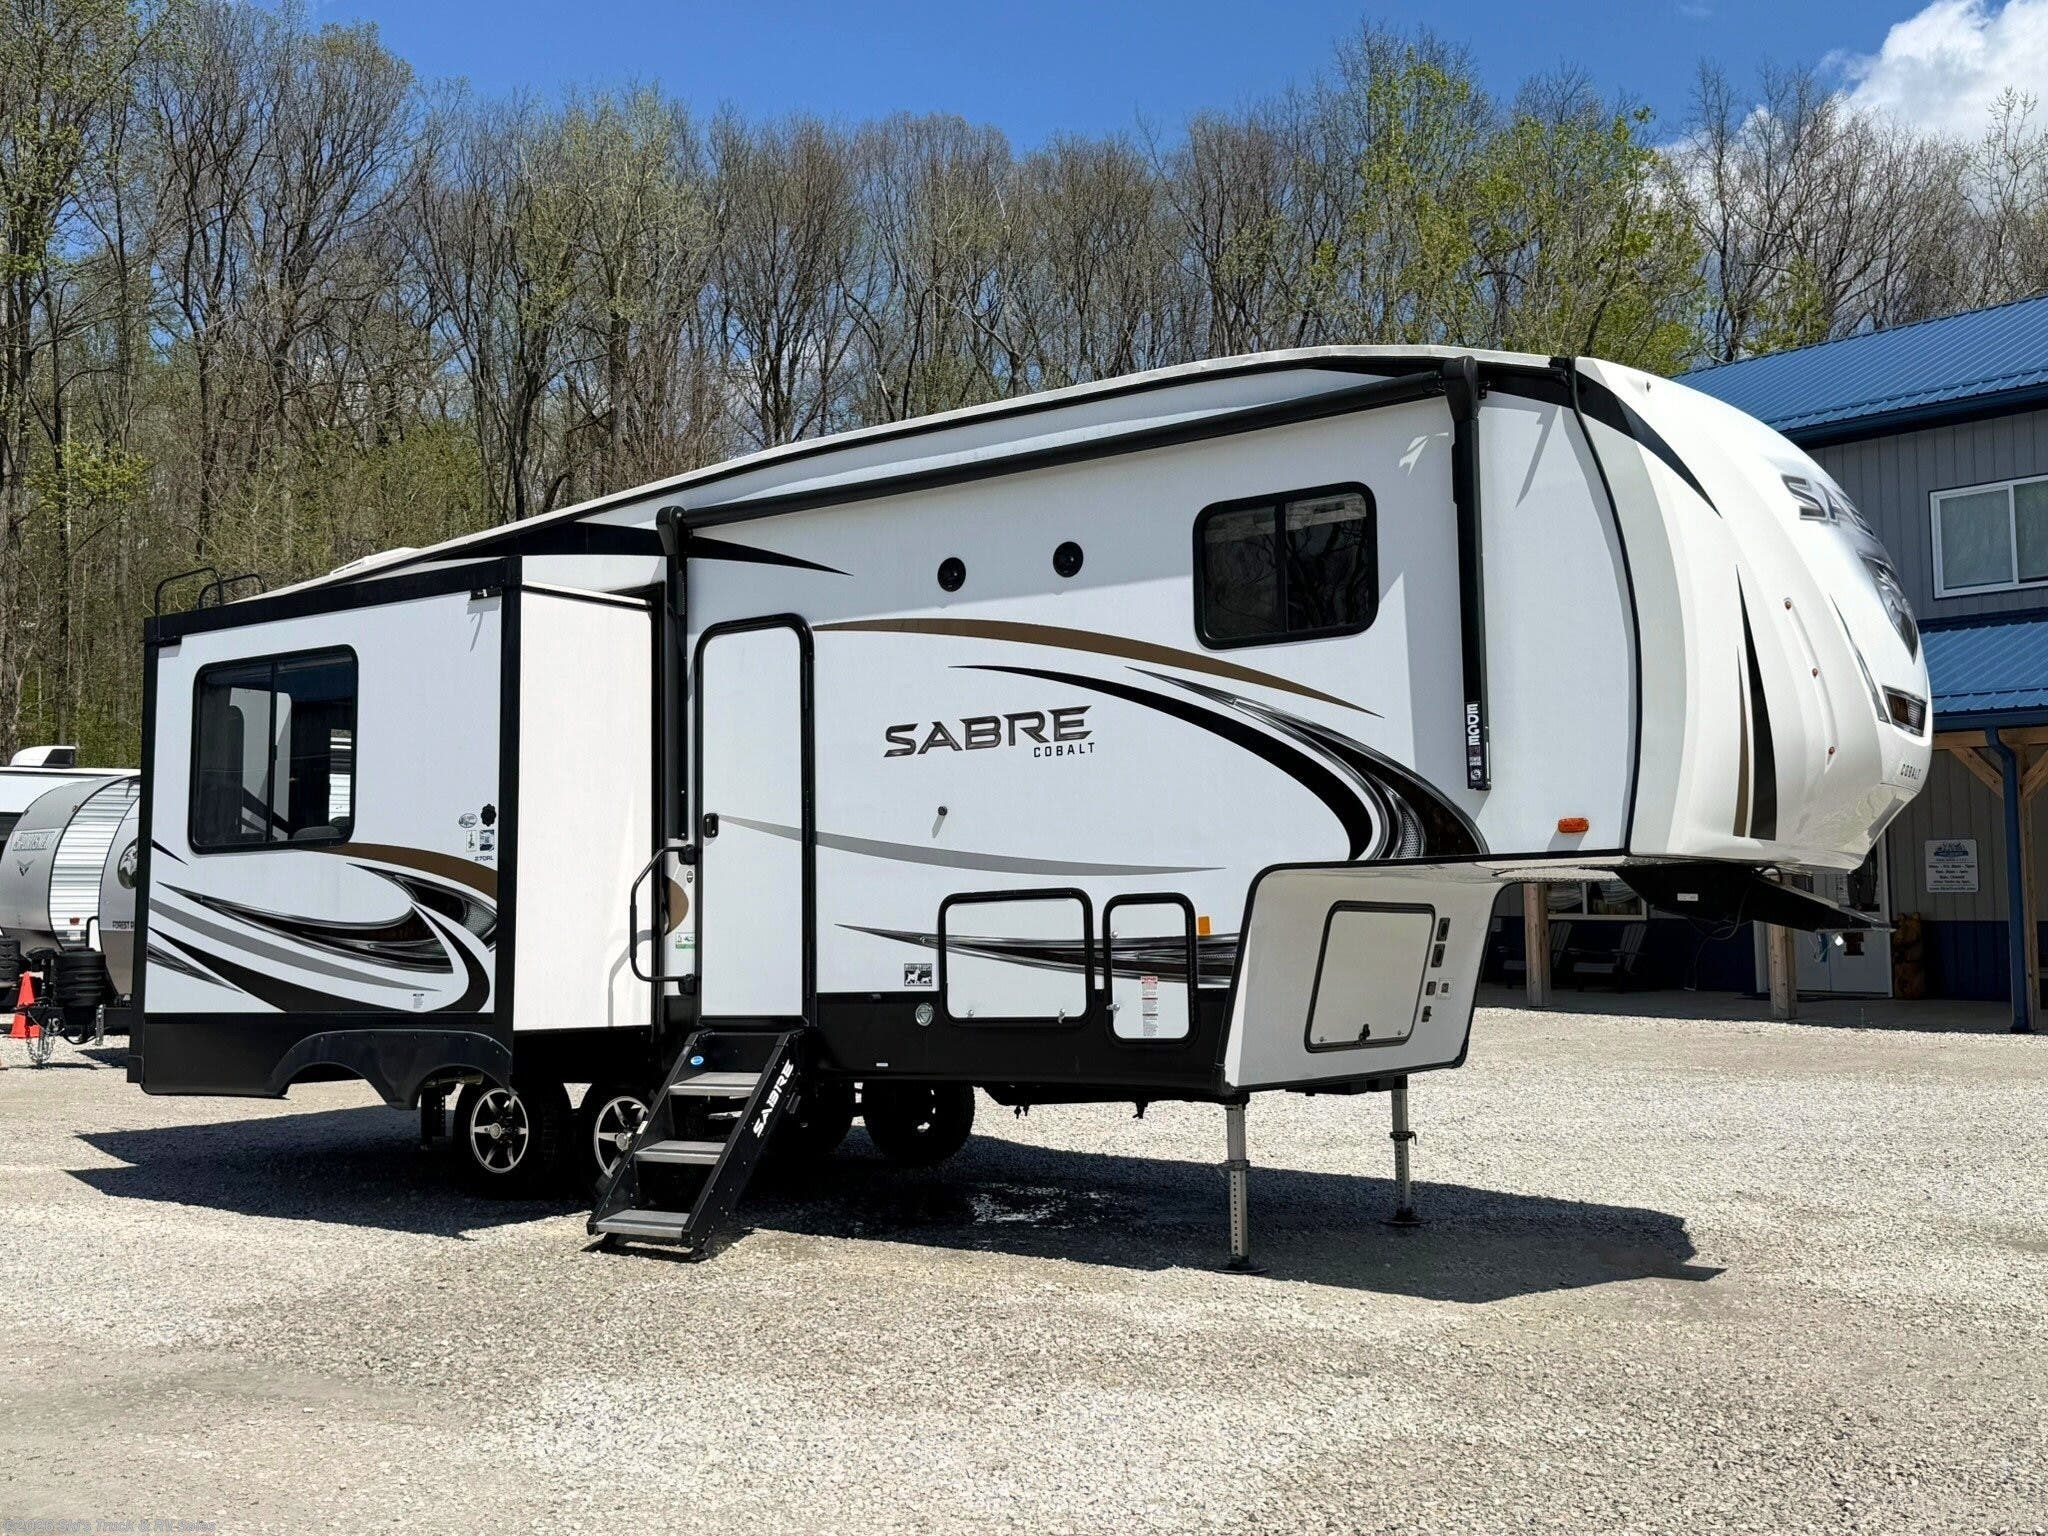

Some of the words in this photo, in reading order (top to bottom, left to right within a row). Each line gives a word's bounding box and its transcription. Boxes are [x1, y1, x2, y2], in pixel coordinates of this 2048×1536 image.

[884, 705, 1093, 758] SABRE
[1466, 703, 1480, 745] EDGE
[1033, 742, 1095, 758] COBALT
[753, 1059, 793, 1137] SABRE
